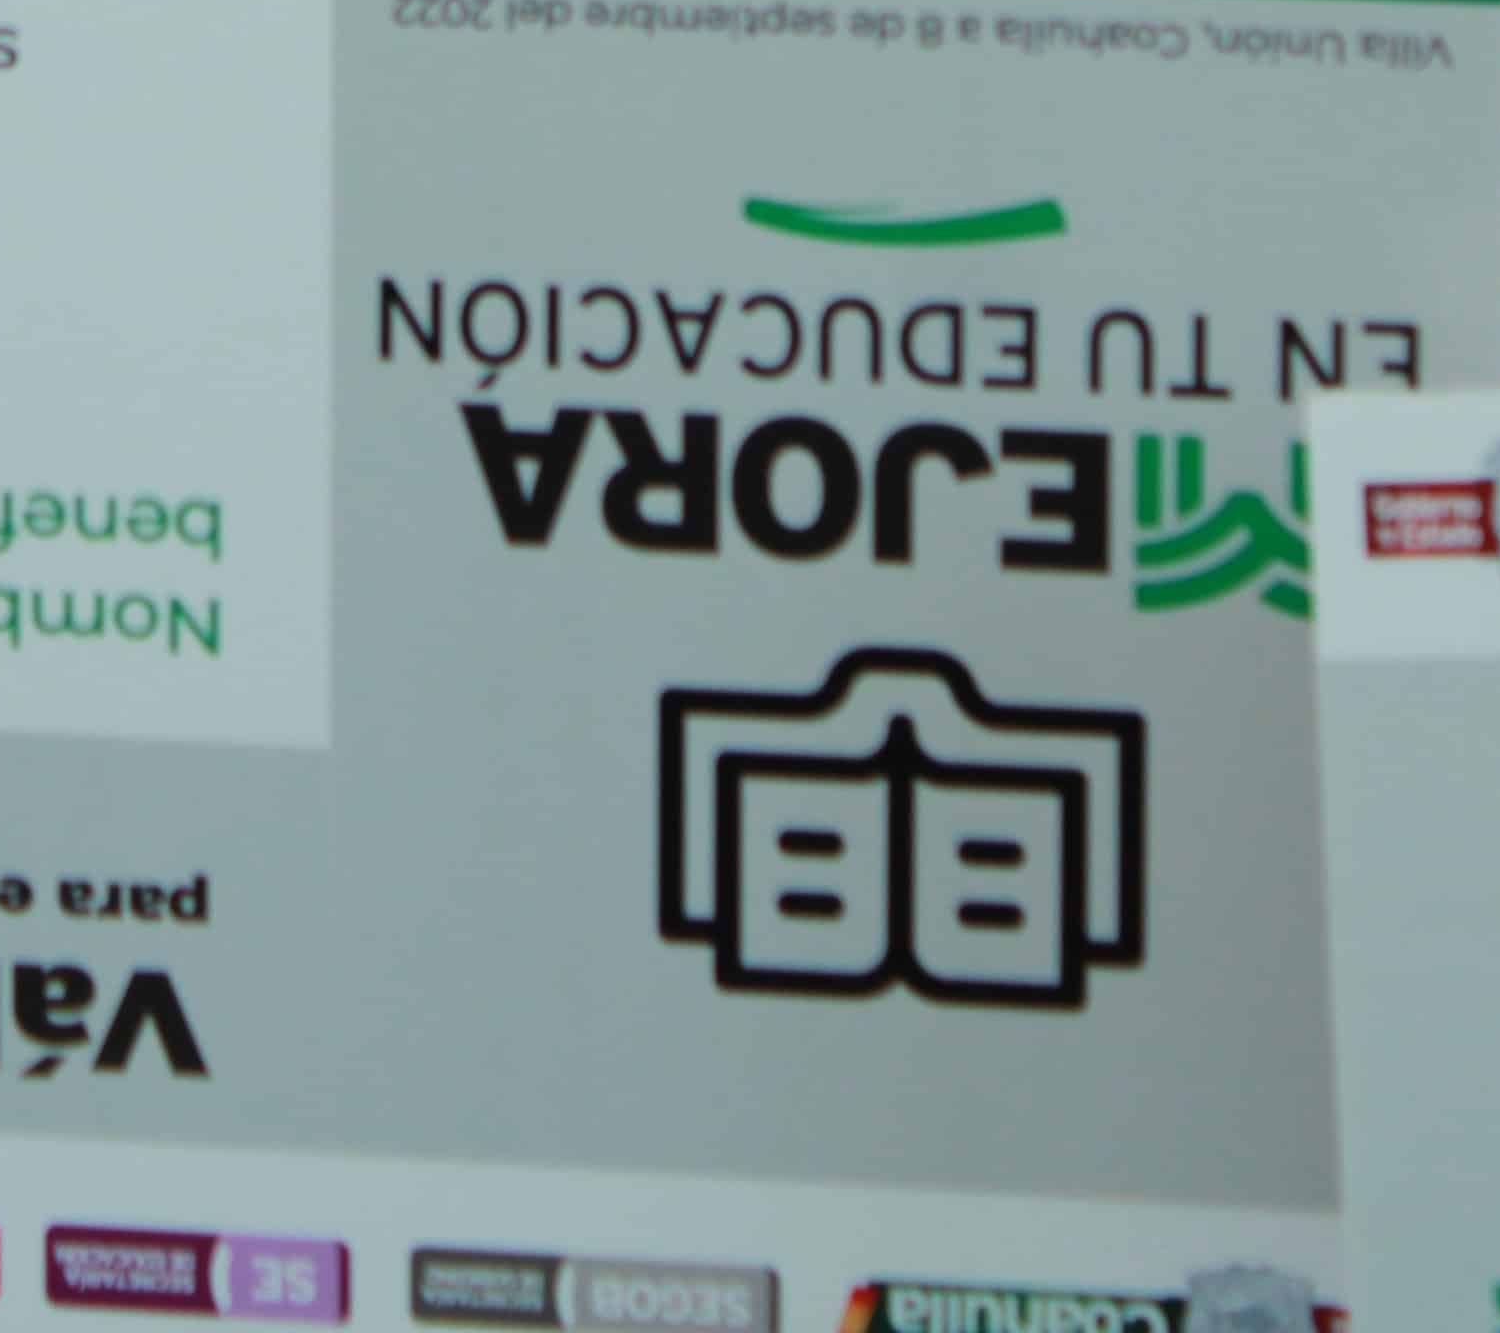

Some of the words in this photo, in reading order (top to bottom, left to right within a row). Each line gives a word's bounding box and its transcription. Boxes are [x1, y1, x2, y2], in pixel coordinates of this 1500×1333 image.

[379, 277, 1038, 391] EDUCACIÓN
[1088, 309, 1231, 401] TU
[1278, 318, 1420, 402] EN
[57, 874, 209, 923] para
